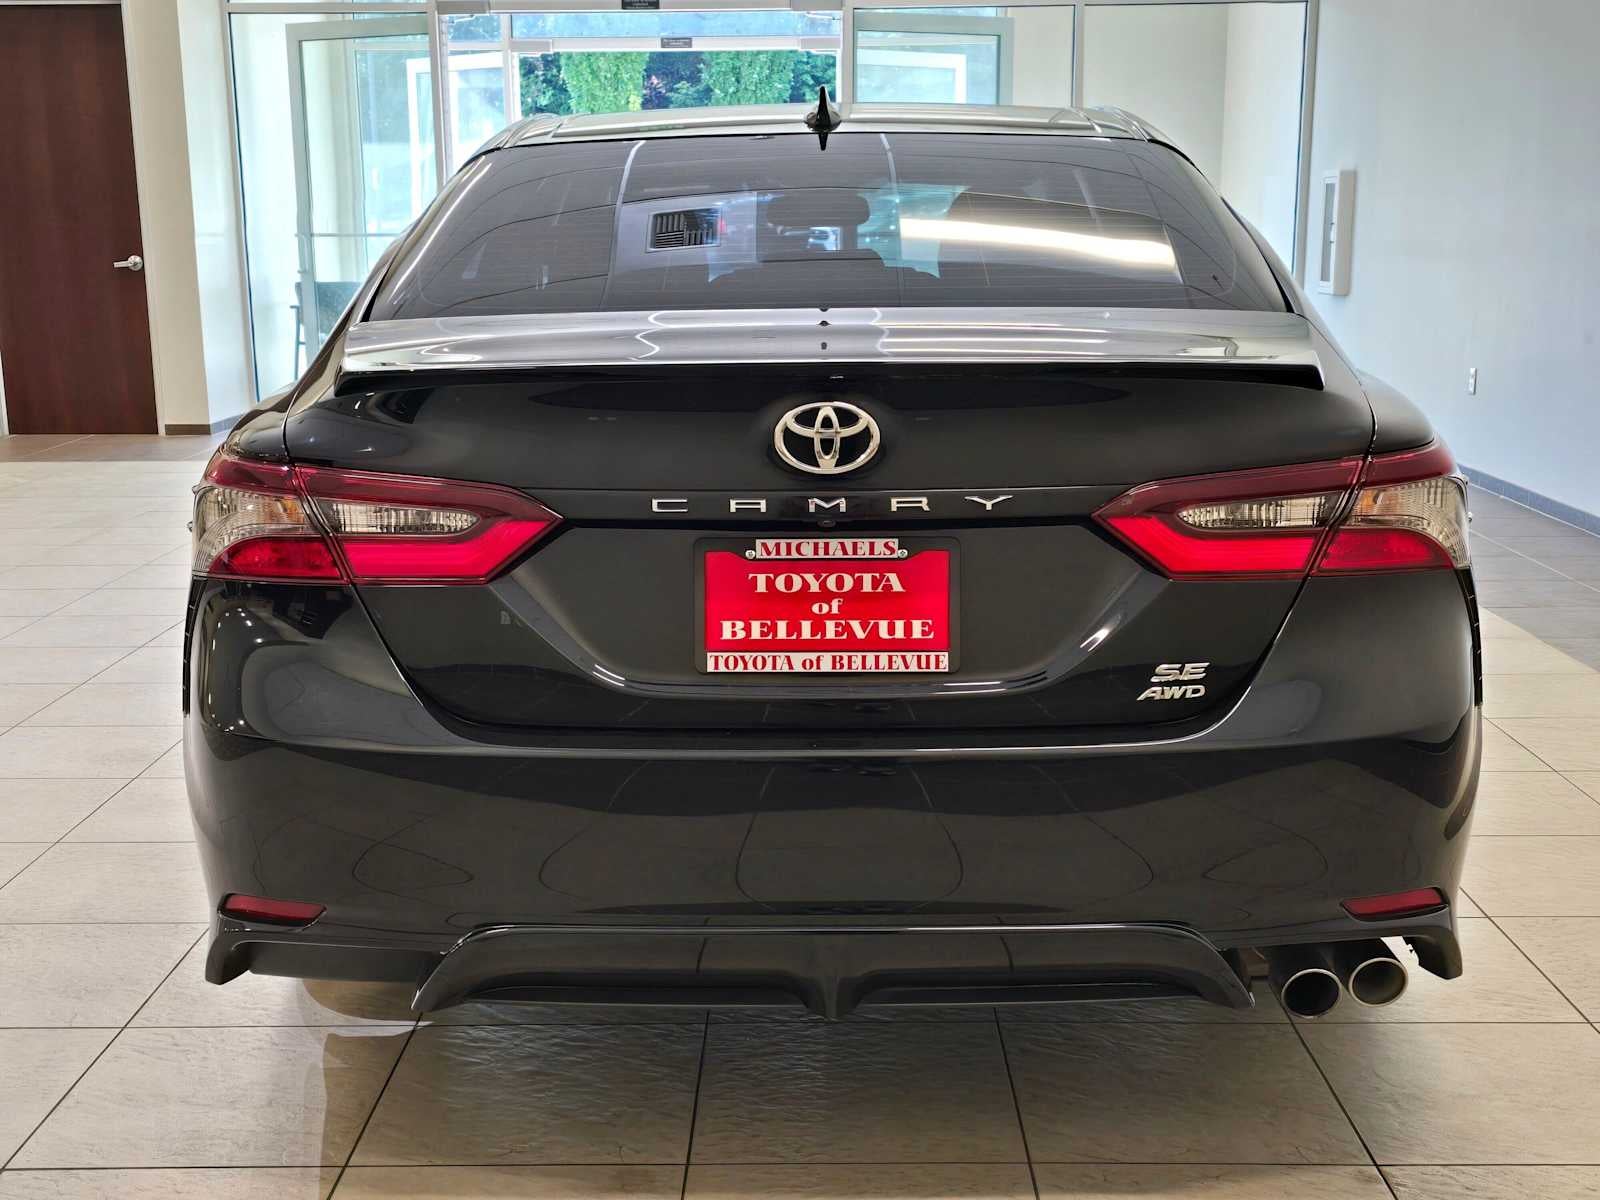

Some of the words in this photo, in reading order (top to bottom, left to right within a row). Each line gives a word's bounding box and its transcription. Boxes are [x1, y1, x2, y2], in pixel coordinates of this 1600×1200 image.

[652, 495, 1013, 513] CAMRY
[760, 541, 897, 557] MICHAELS
[748, 573, 906, 593] TOYOTA
[811, 597, 843, 615] of
[720, 619, 934, 640] BELLEVUE
[709, 654, 793, 671] TOYOTA
[801, 654, 824, 671] of
[831, 654, 947, 671] BELLEVUE
[1150, 662, 1211, 682] SE
[1136, 685, 1206, 701] AWD
